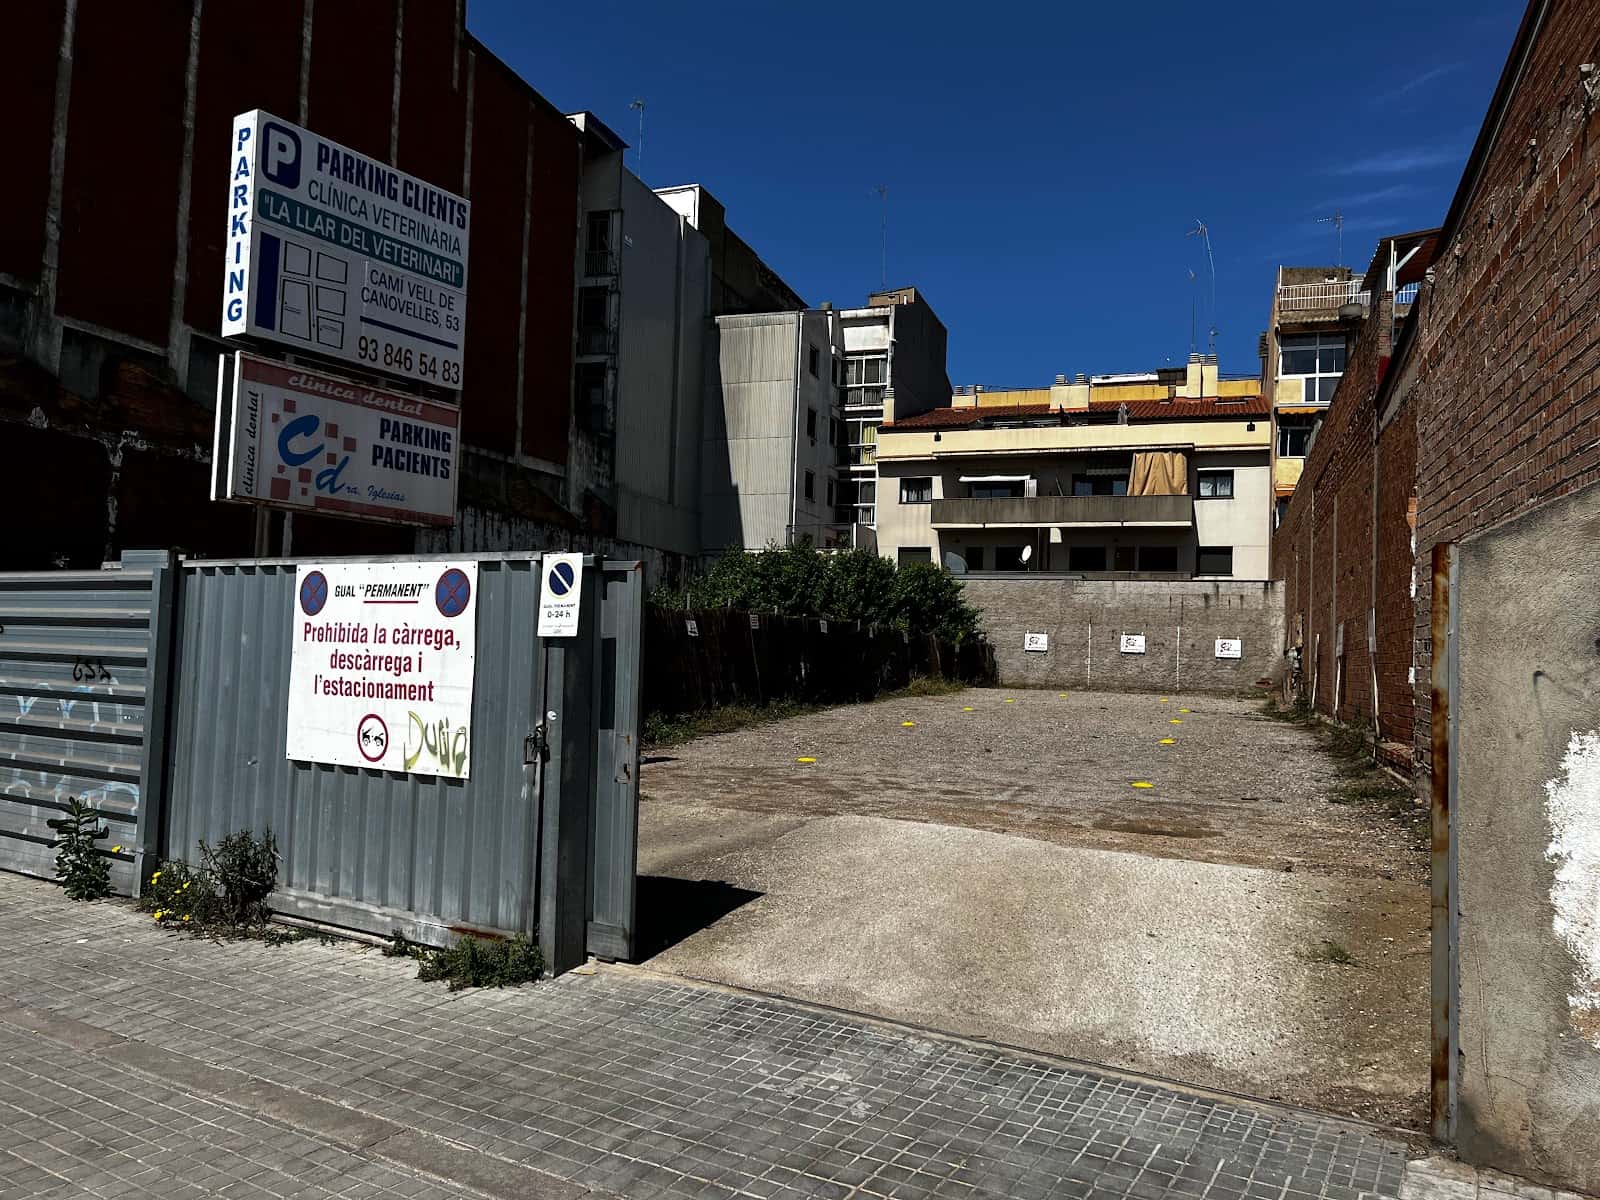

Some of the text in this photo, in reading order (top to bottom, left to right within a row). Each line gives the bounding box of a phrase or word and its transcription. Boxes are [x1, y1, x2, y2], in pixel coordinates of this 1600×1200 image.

[308, 180, 369, 221] CLÍNICA
[316, 142, 467, 230] PARKING CLIENTS
[227, 127, 251, 321] PARKING
[296, 208, 336, 241] LLAR
[340, 224, 369, 256] DEL
[361, 286, 460, 332] CANOVELLES, 53
[407, 280, 435, 304] VELL
[439, 293, 455, 312] DE
[358, 336, 460, 384] 93 846 54 83
[249, 391, 260, 438] dental
[288, 374, 423, 416] clinica dental
[379, 417, 452, 453] PARKING
[371, 444, 450, 480] PACIENTS
[334, 584, 356, 598] GUAL
[304, 622, 461, 650] Prohibida la càrrega,
[330, 649, 423, 676] descàrrega i
[314, 674, 435, 702] l'estacionament
